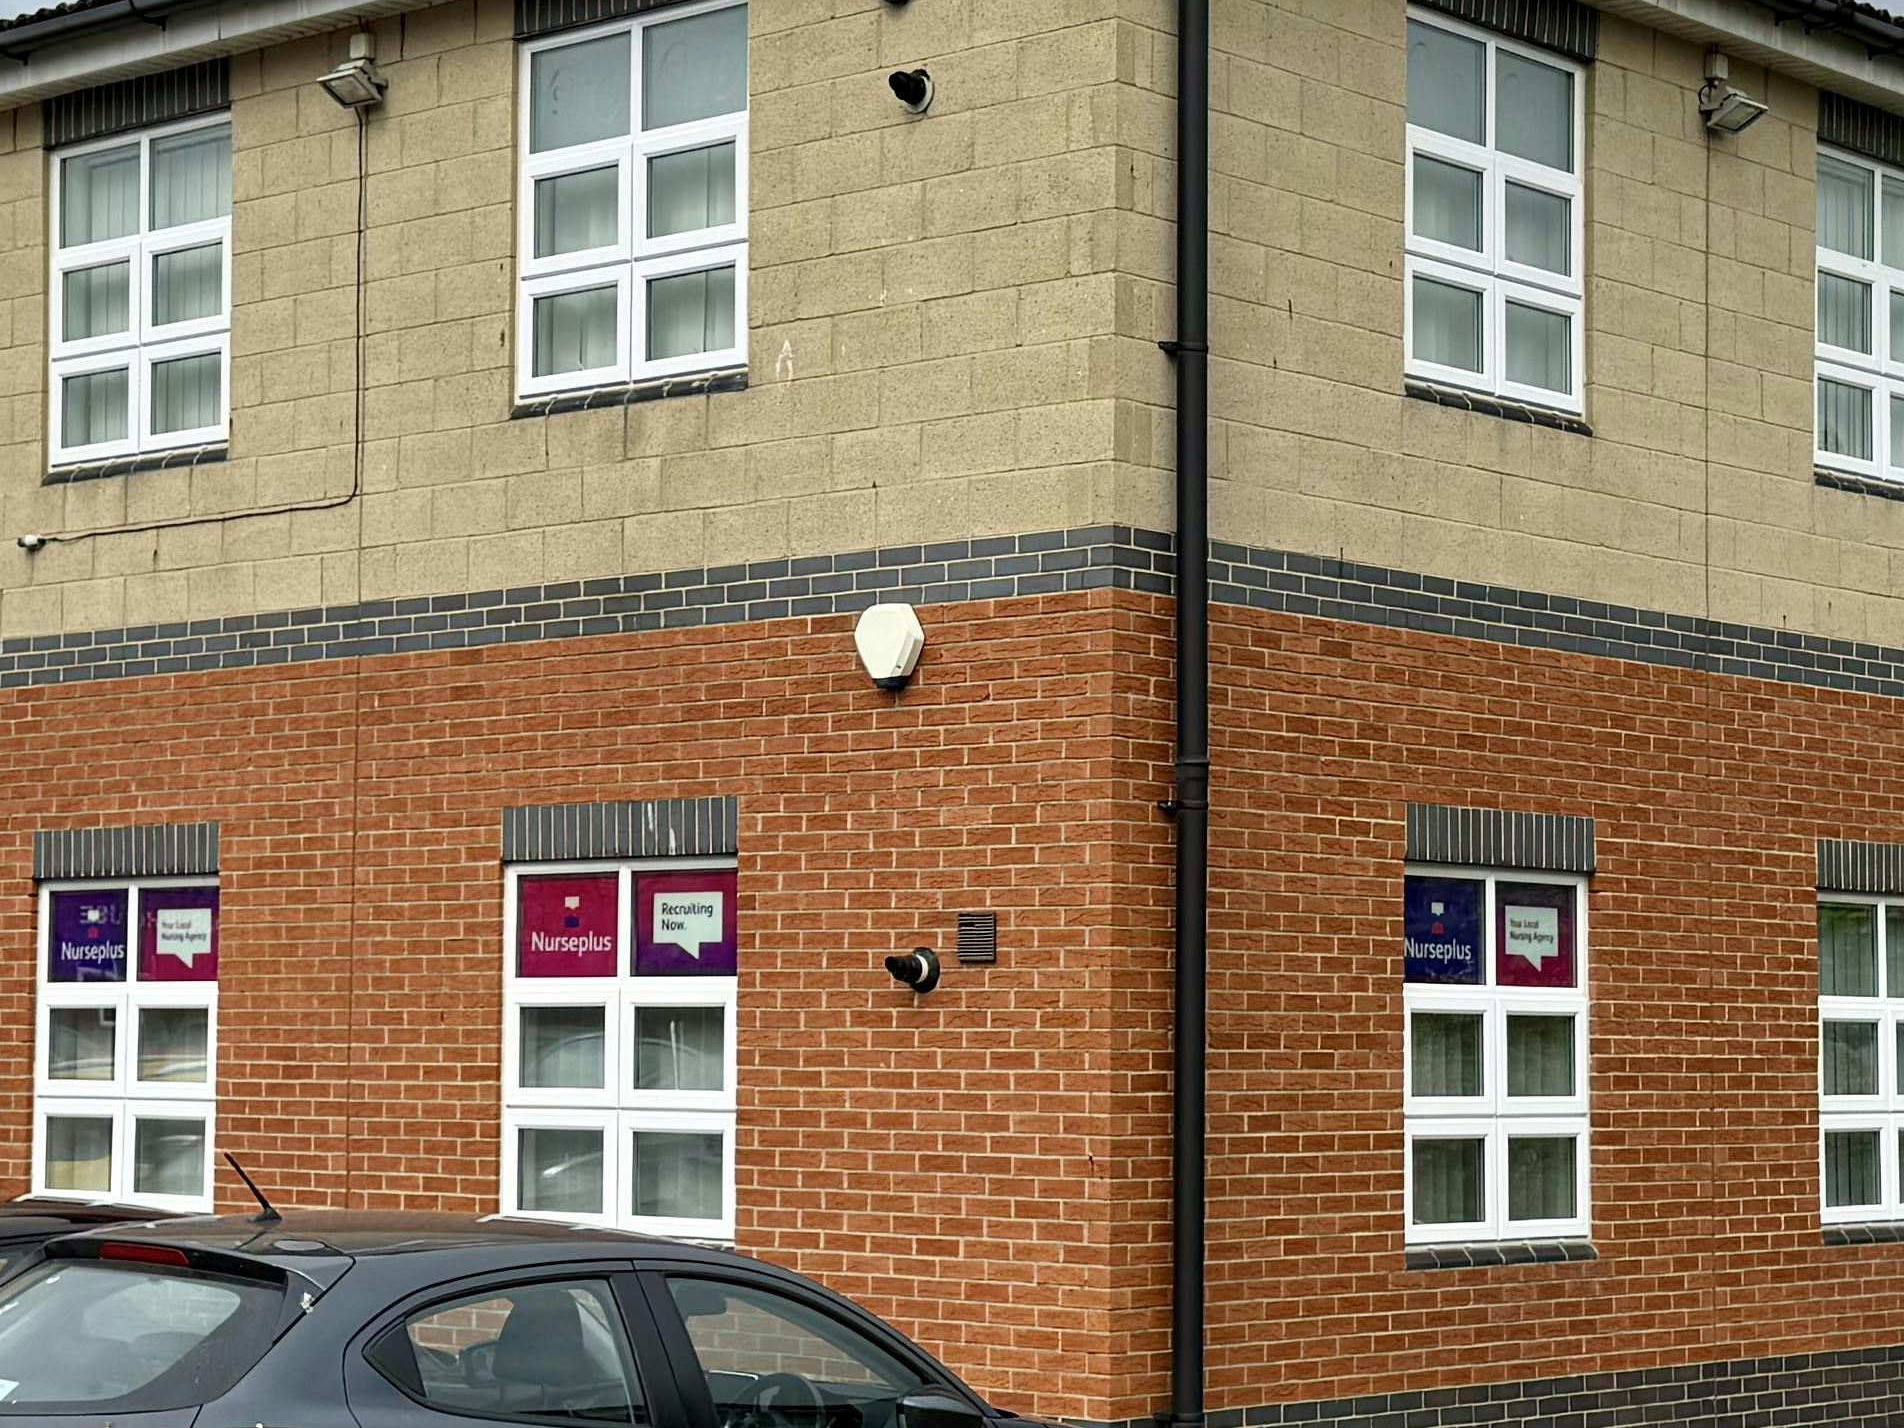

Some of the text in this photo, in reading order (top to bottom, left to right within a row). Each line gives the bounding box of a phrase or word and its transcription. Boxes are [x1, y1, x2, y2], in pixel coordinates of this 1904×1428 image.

[662, 903, 713, 917] Recruiting
[61, 940, 125, 964] Nurseplus
[531, 931, 612, 957] Nurseplus
[1404, 937, 1472, 964] Nurseplus
